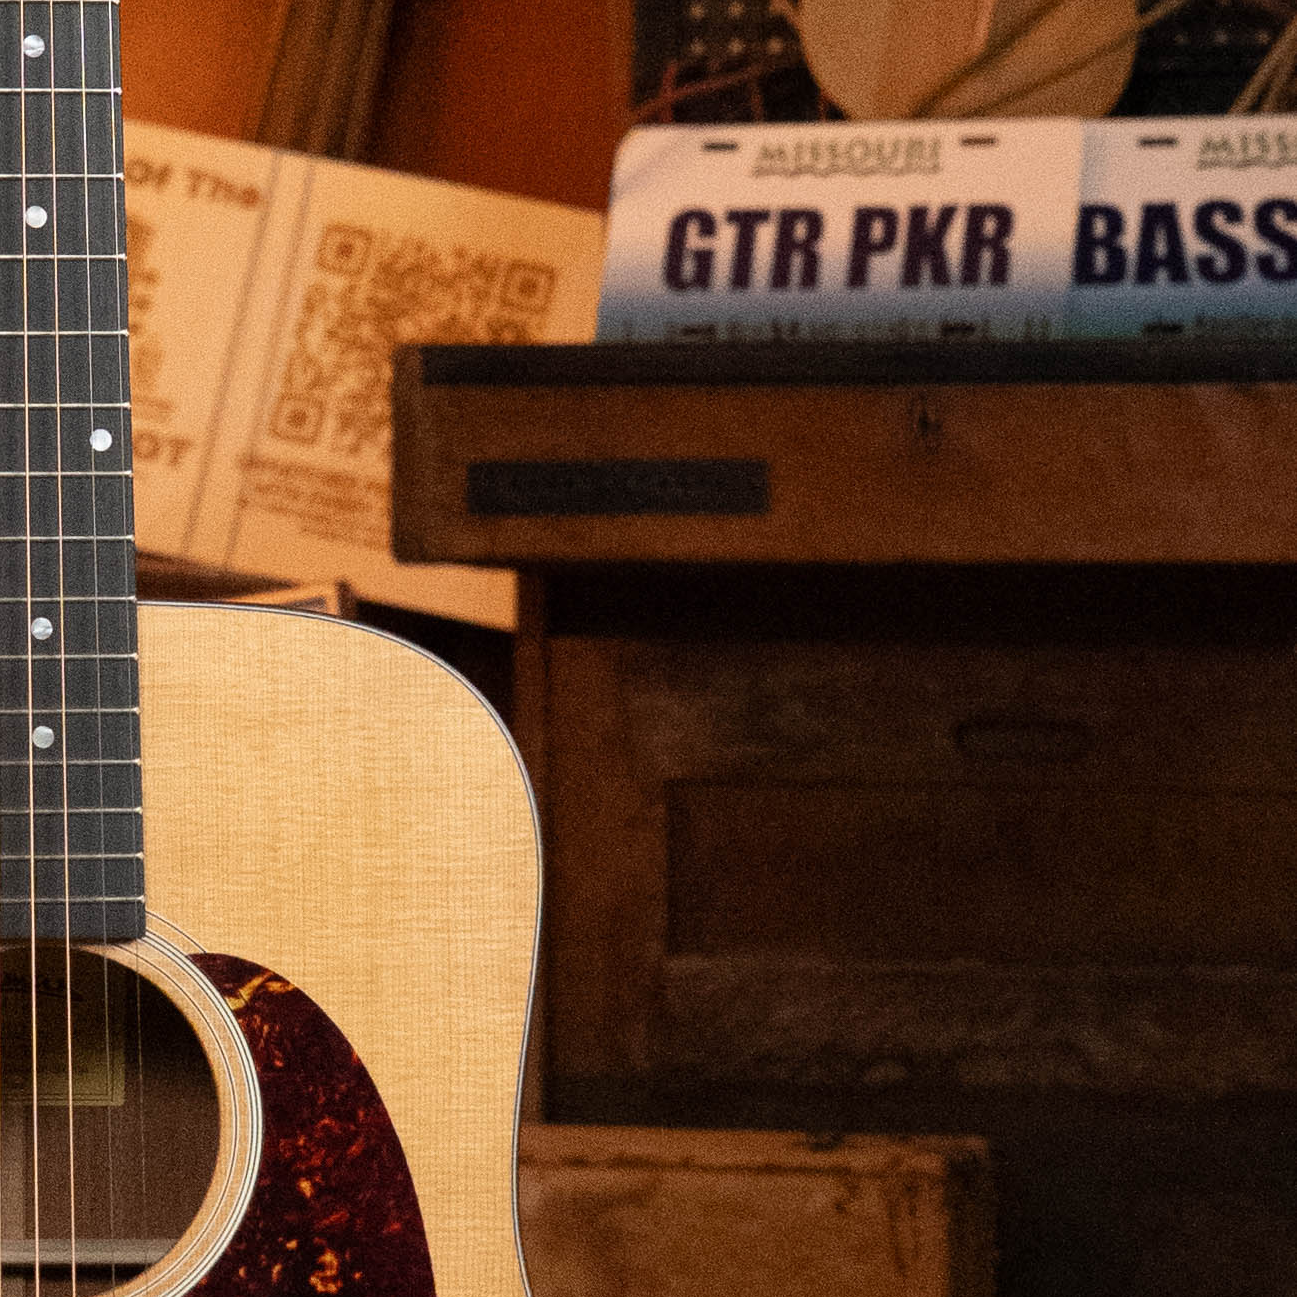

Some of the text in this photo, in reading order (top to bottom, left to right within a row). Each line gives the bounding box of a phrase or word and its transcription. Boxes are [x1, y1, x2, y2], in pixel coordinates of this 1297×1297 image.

[755, 136, 942, 172] MISSOURI
[1199, 130, 1297, 165] MISS
[663, 202, 1016, 292] GTR PKR
[1072, 198, 1297, 286] BASS
